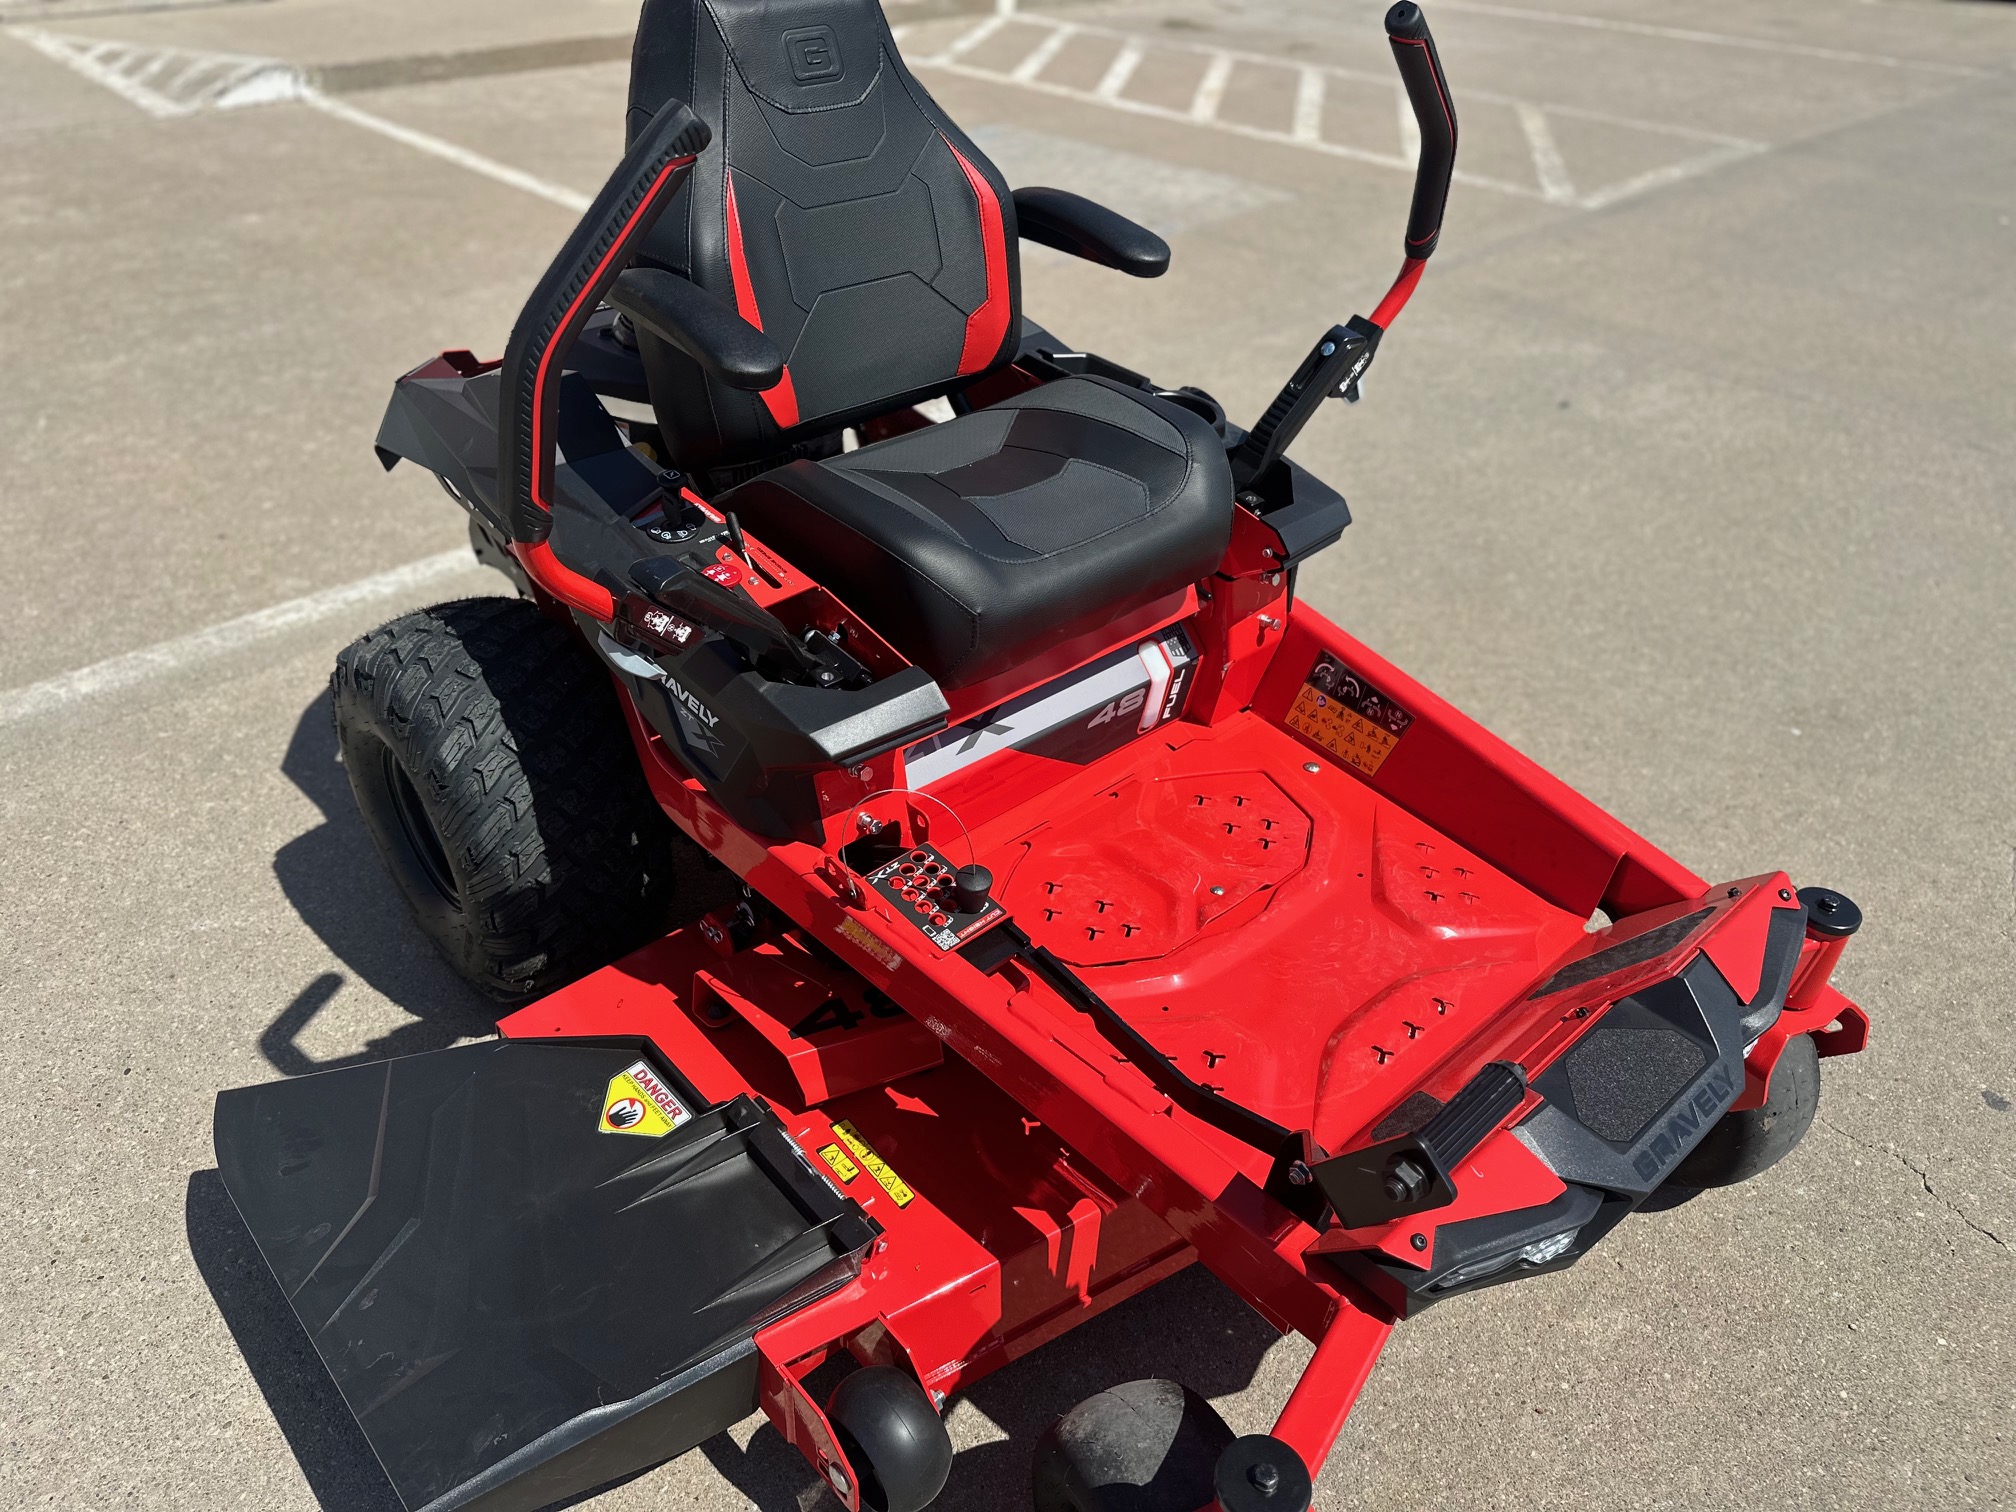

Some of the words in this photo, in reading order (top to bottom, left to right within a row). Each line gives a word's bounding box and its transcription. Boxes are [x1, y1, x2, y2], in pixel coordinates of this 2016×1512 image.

[1087, 688, 1146, 729] 48
[1162, 669, 1185, 719] FUEL
[959, 920, 986, 939] HEIGHT
[986, 910, 1002, 922] CUT
[623, 1075, 634, 1086] KEEP
[632, 1085, 646, 1099] HANDS
[644, 1099, 653, 1107] and
[650, 1106, 662, 1116] FEET
[660, 1116, 672, 1128] AWAY
[633, 1069, 684, 1120] DANGER
[1632, 1064, 1735, 1182] GRAVELY
